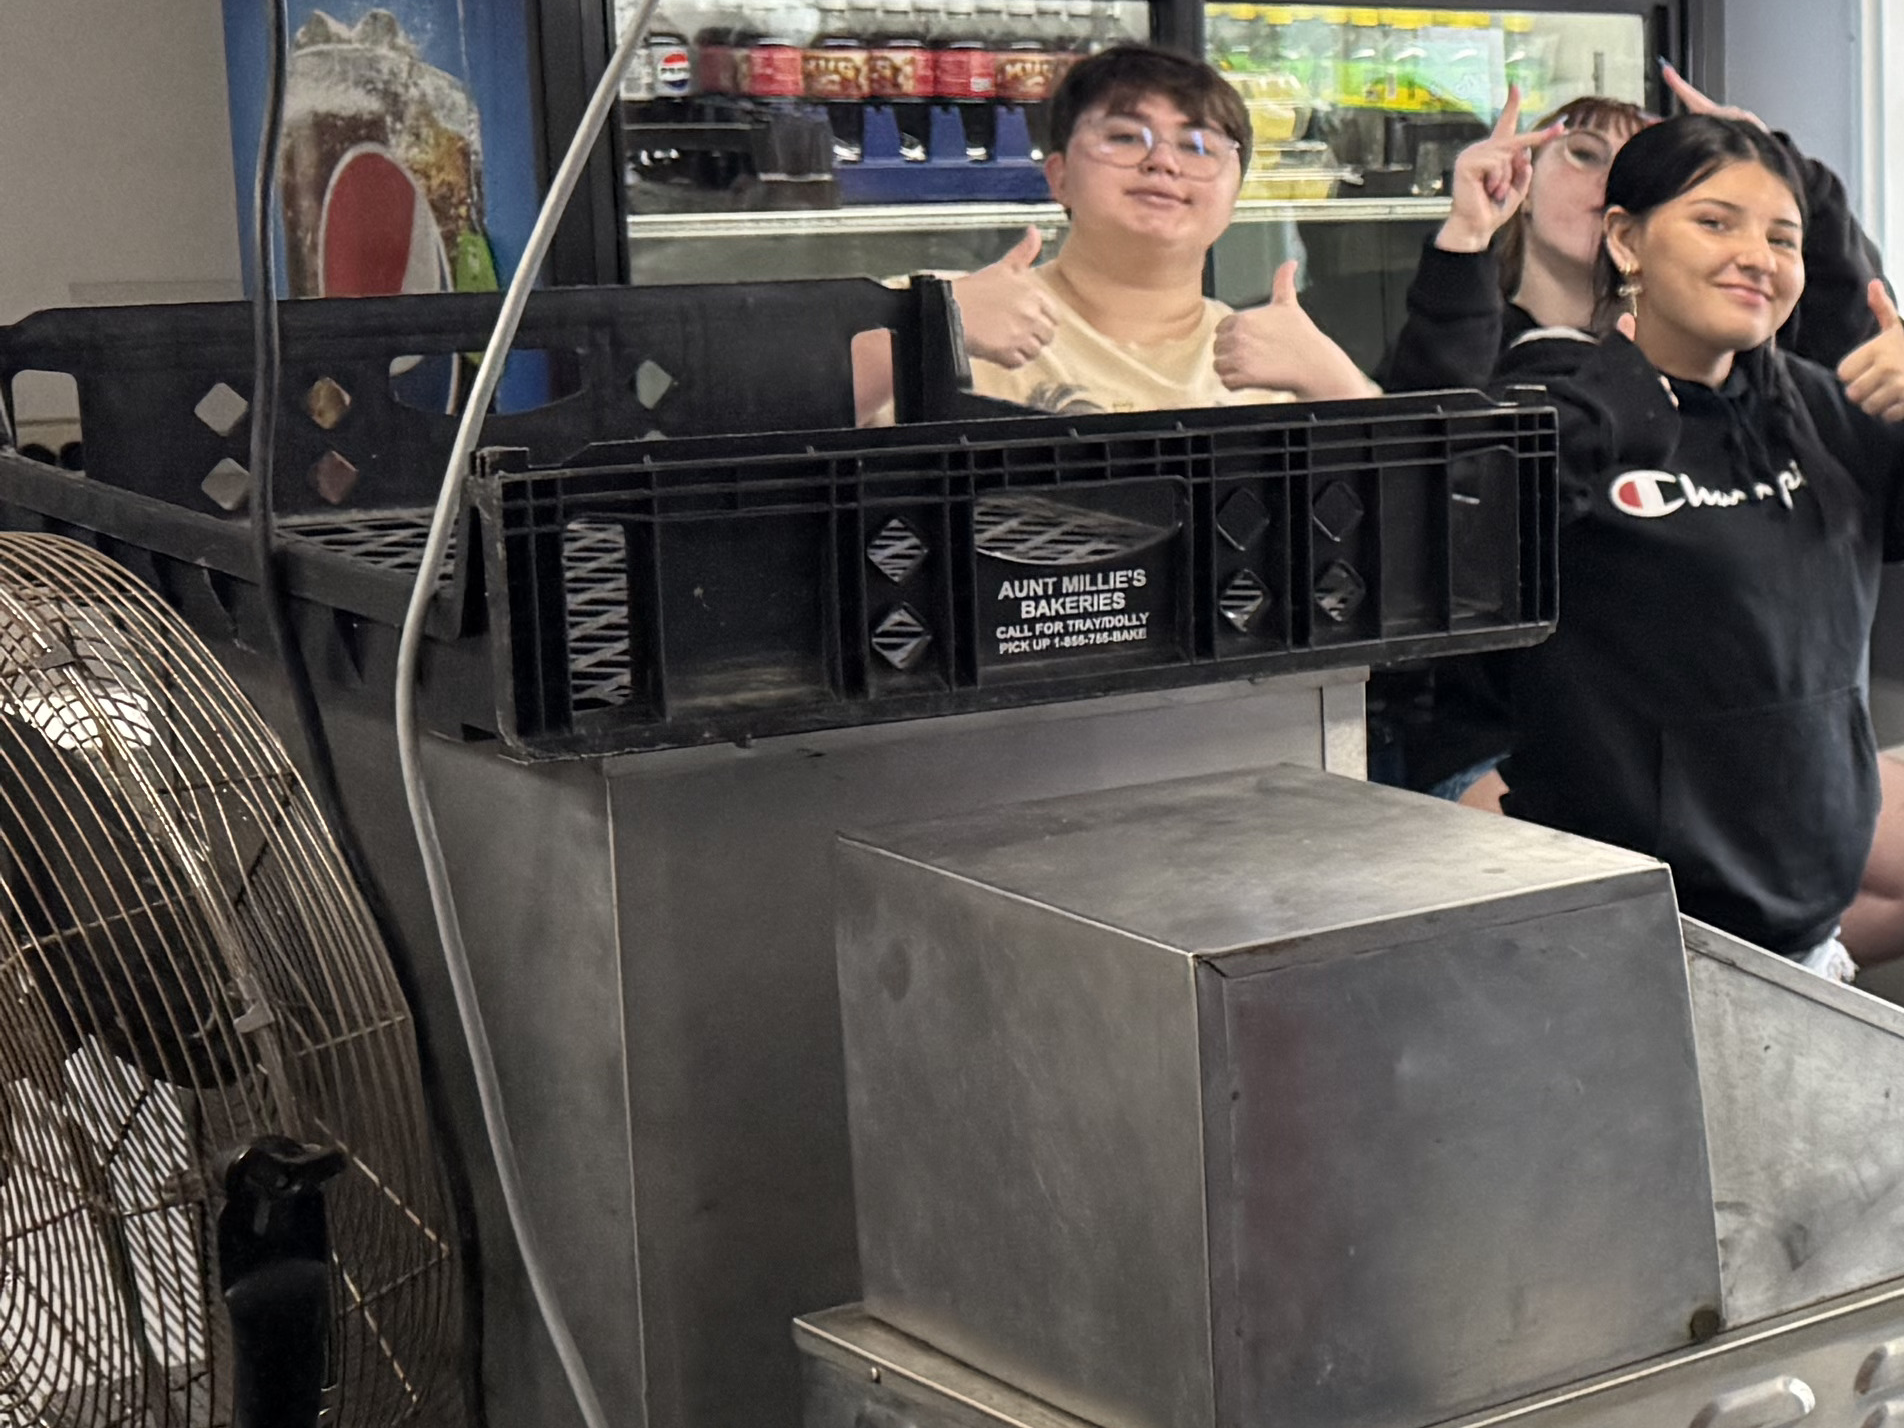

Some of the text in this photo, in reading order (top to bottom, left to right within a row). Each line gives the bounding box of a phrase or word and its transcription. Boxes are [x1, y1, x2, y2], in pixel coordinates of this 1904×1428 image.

[998, 569, 1147, 600] AUNT MILLIE'S
[1021, 591, 1126, 619] BAKERIES
[996, 612, 1150, 639] CALL FOR TRAY/DOLLY
[999, 640, 1030, 654] PICK
[1032, 637, 1050, 651] UP
